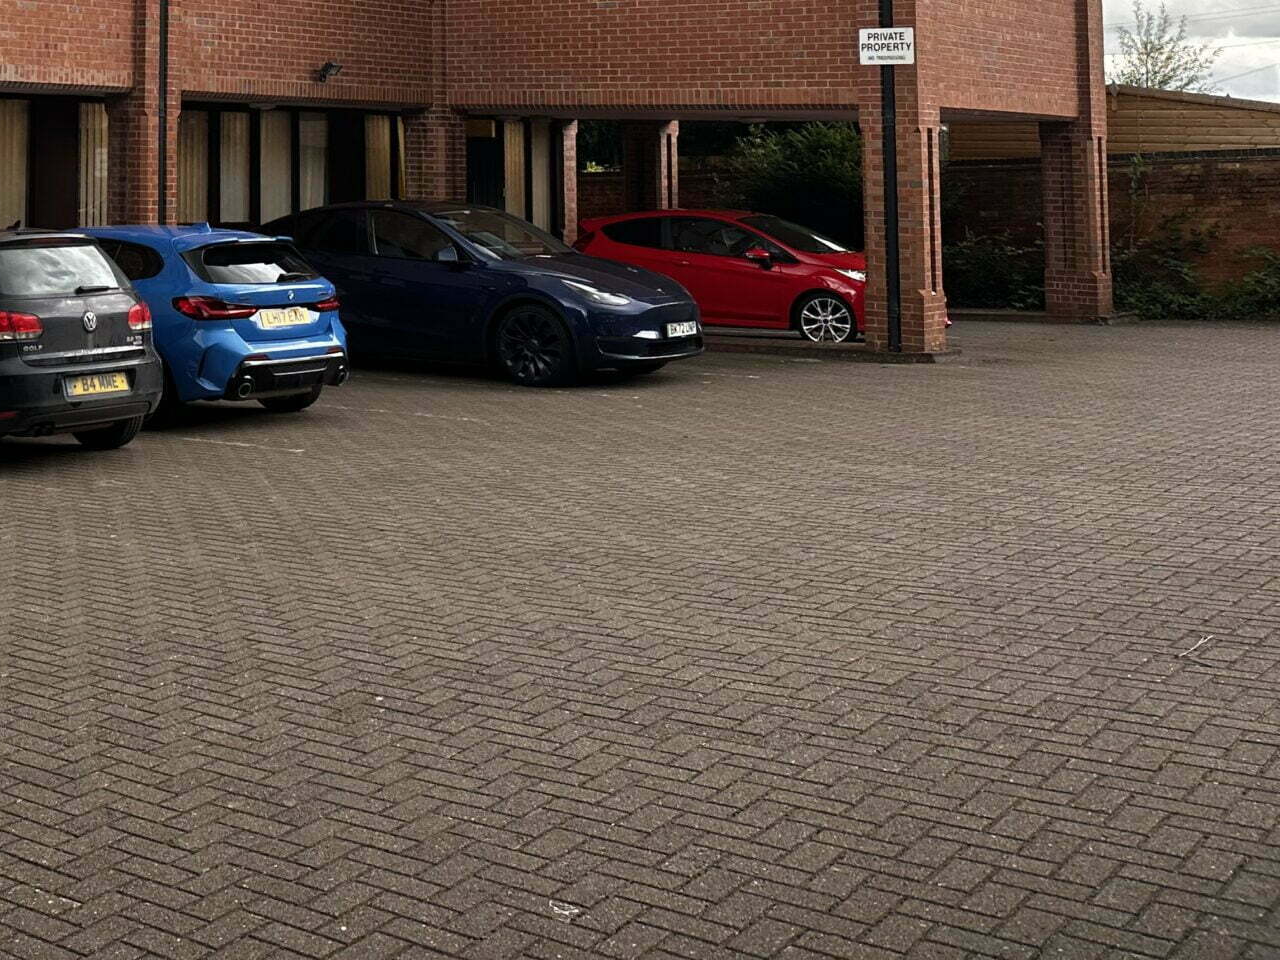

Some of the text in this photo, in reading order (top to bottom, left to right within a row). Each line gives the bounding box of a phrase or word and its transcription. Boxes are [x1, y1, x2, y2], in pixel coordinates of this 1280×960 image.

[867, 32, 905, 41] PRIVATE
[861, 42, 911, 51] PROPERTY
[82, 376, 96, 392] B4
